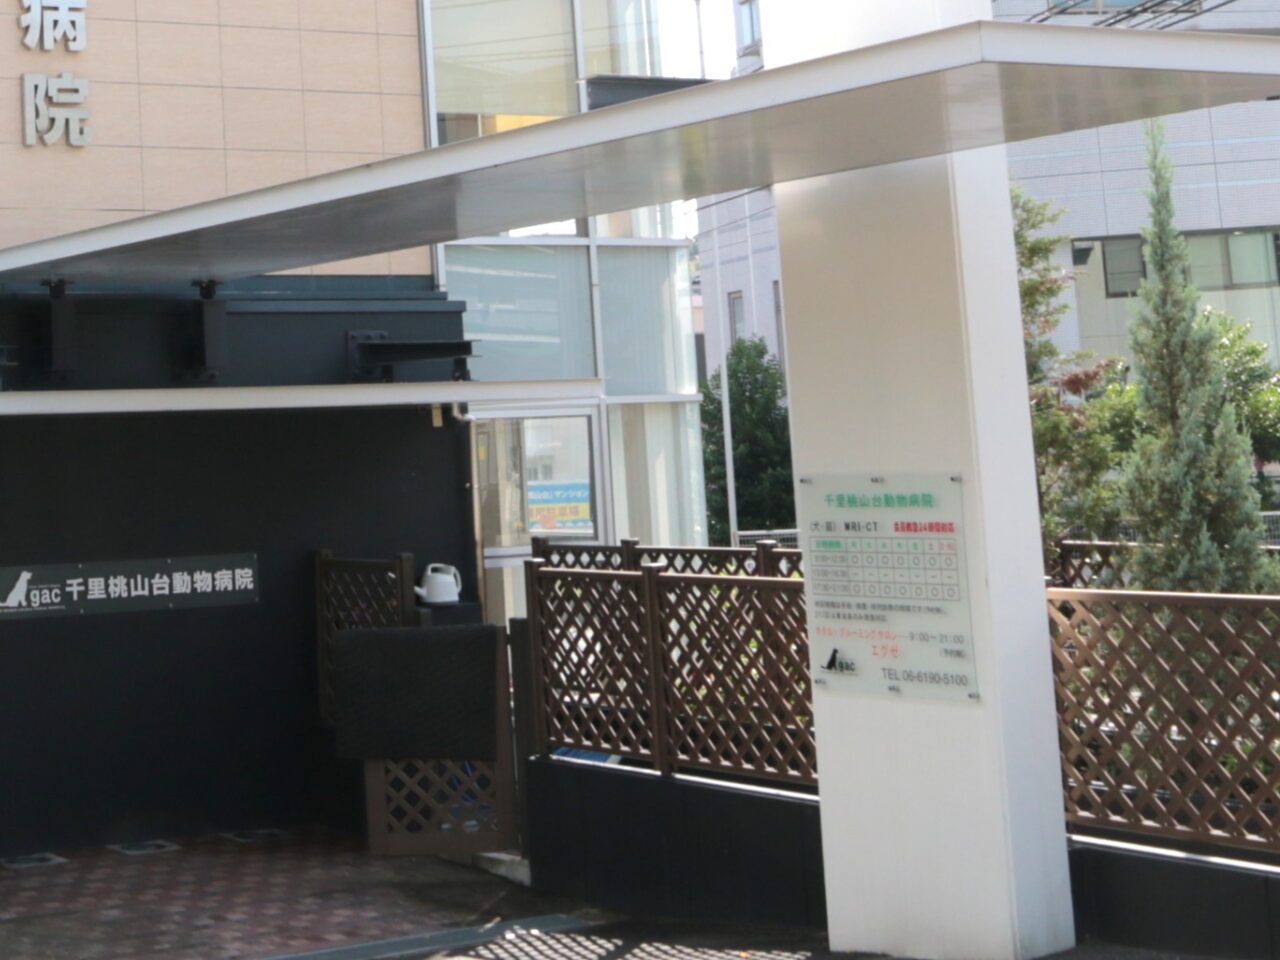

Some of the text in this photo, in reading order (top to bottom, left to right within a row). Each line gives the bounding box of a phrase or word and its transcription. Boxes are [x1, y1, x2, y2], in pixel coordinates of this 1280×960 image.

[824, 493, 936, 509] 千里桃山台動物病院
[65, 568, 254, 601] 千里桃山台動物病院
[30, 587, 61, 608] gac
[882, 667, 900, 680] TEL
